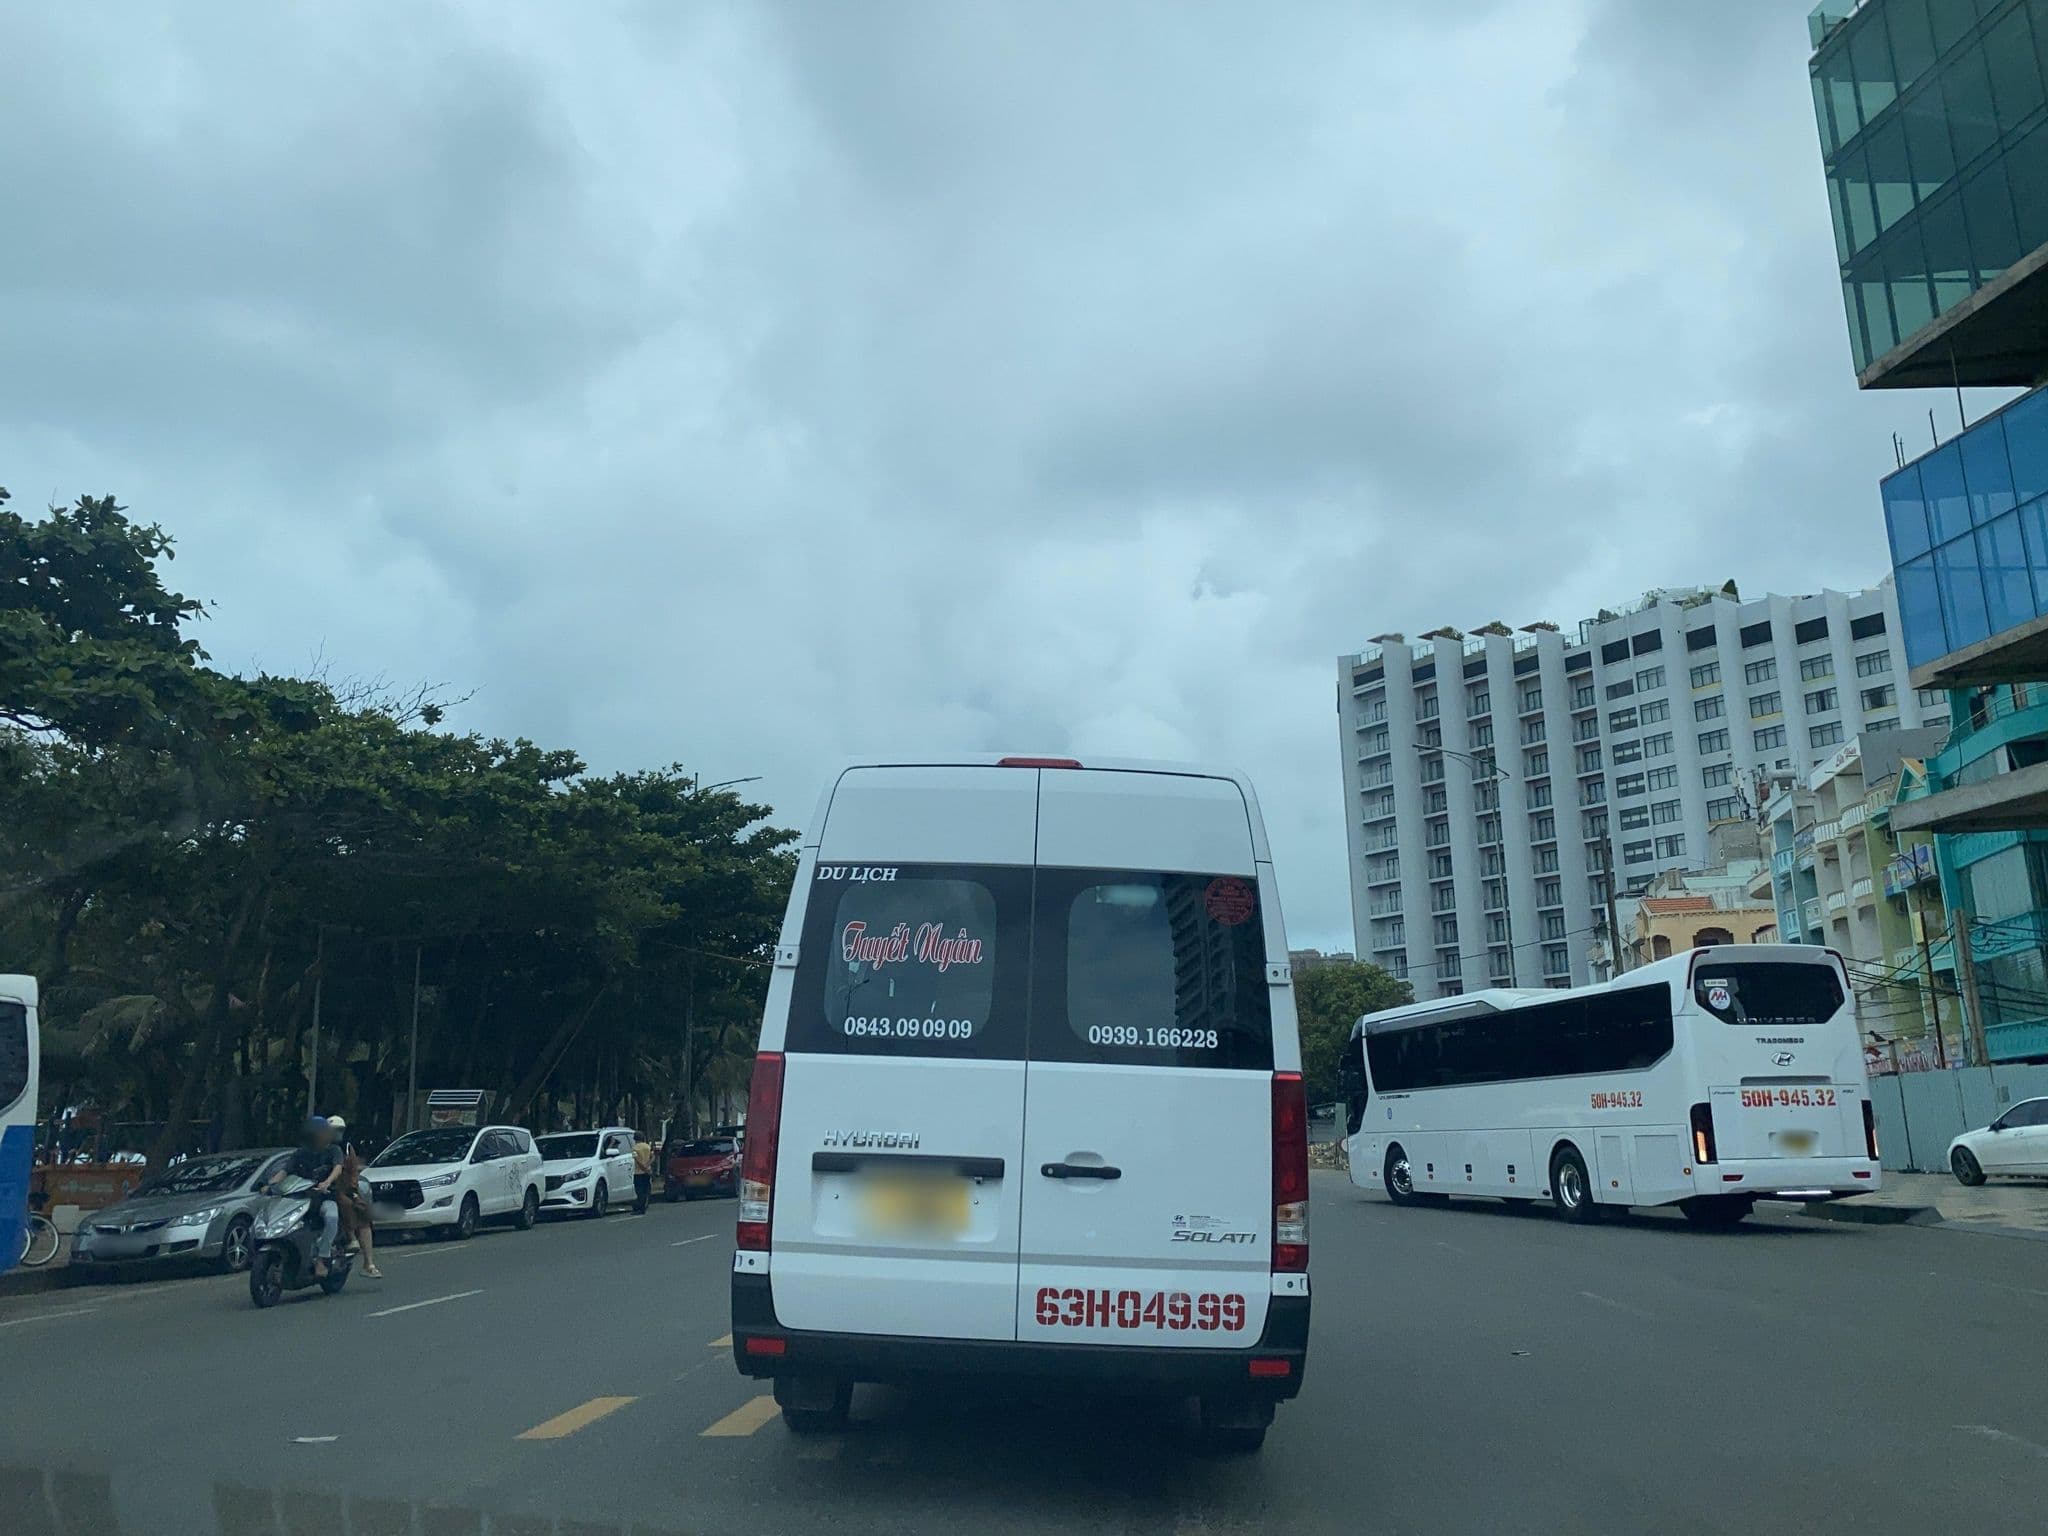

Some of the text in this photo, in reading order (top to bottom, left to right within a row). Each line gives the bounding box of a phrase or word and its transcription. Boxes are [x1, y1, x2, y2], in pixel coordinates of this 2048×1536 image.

[817, 867, 898, 884] DU LỊCH
[842, 920, 983, 973] Tuyết Ngân
[1088, 1025, 1219, 1049] 0939.166228
[1590, 1090, 1643, 1110] 50H-945.32
[1740, 1088, 1837, 1108] 50H-945.32
[823, 1129, 921, 1149] HYUNDAI
[1170, 1230, 1257, 1244] SOLATI
[1036, 1287, 1246, 1332] 63H-049.99
